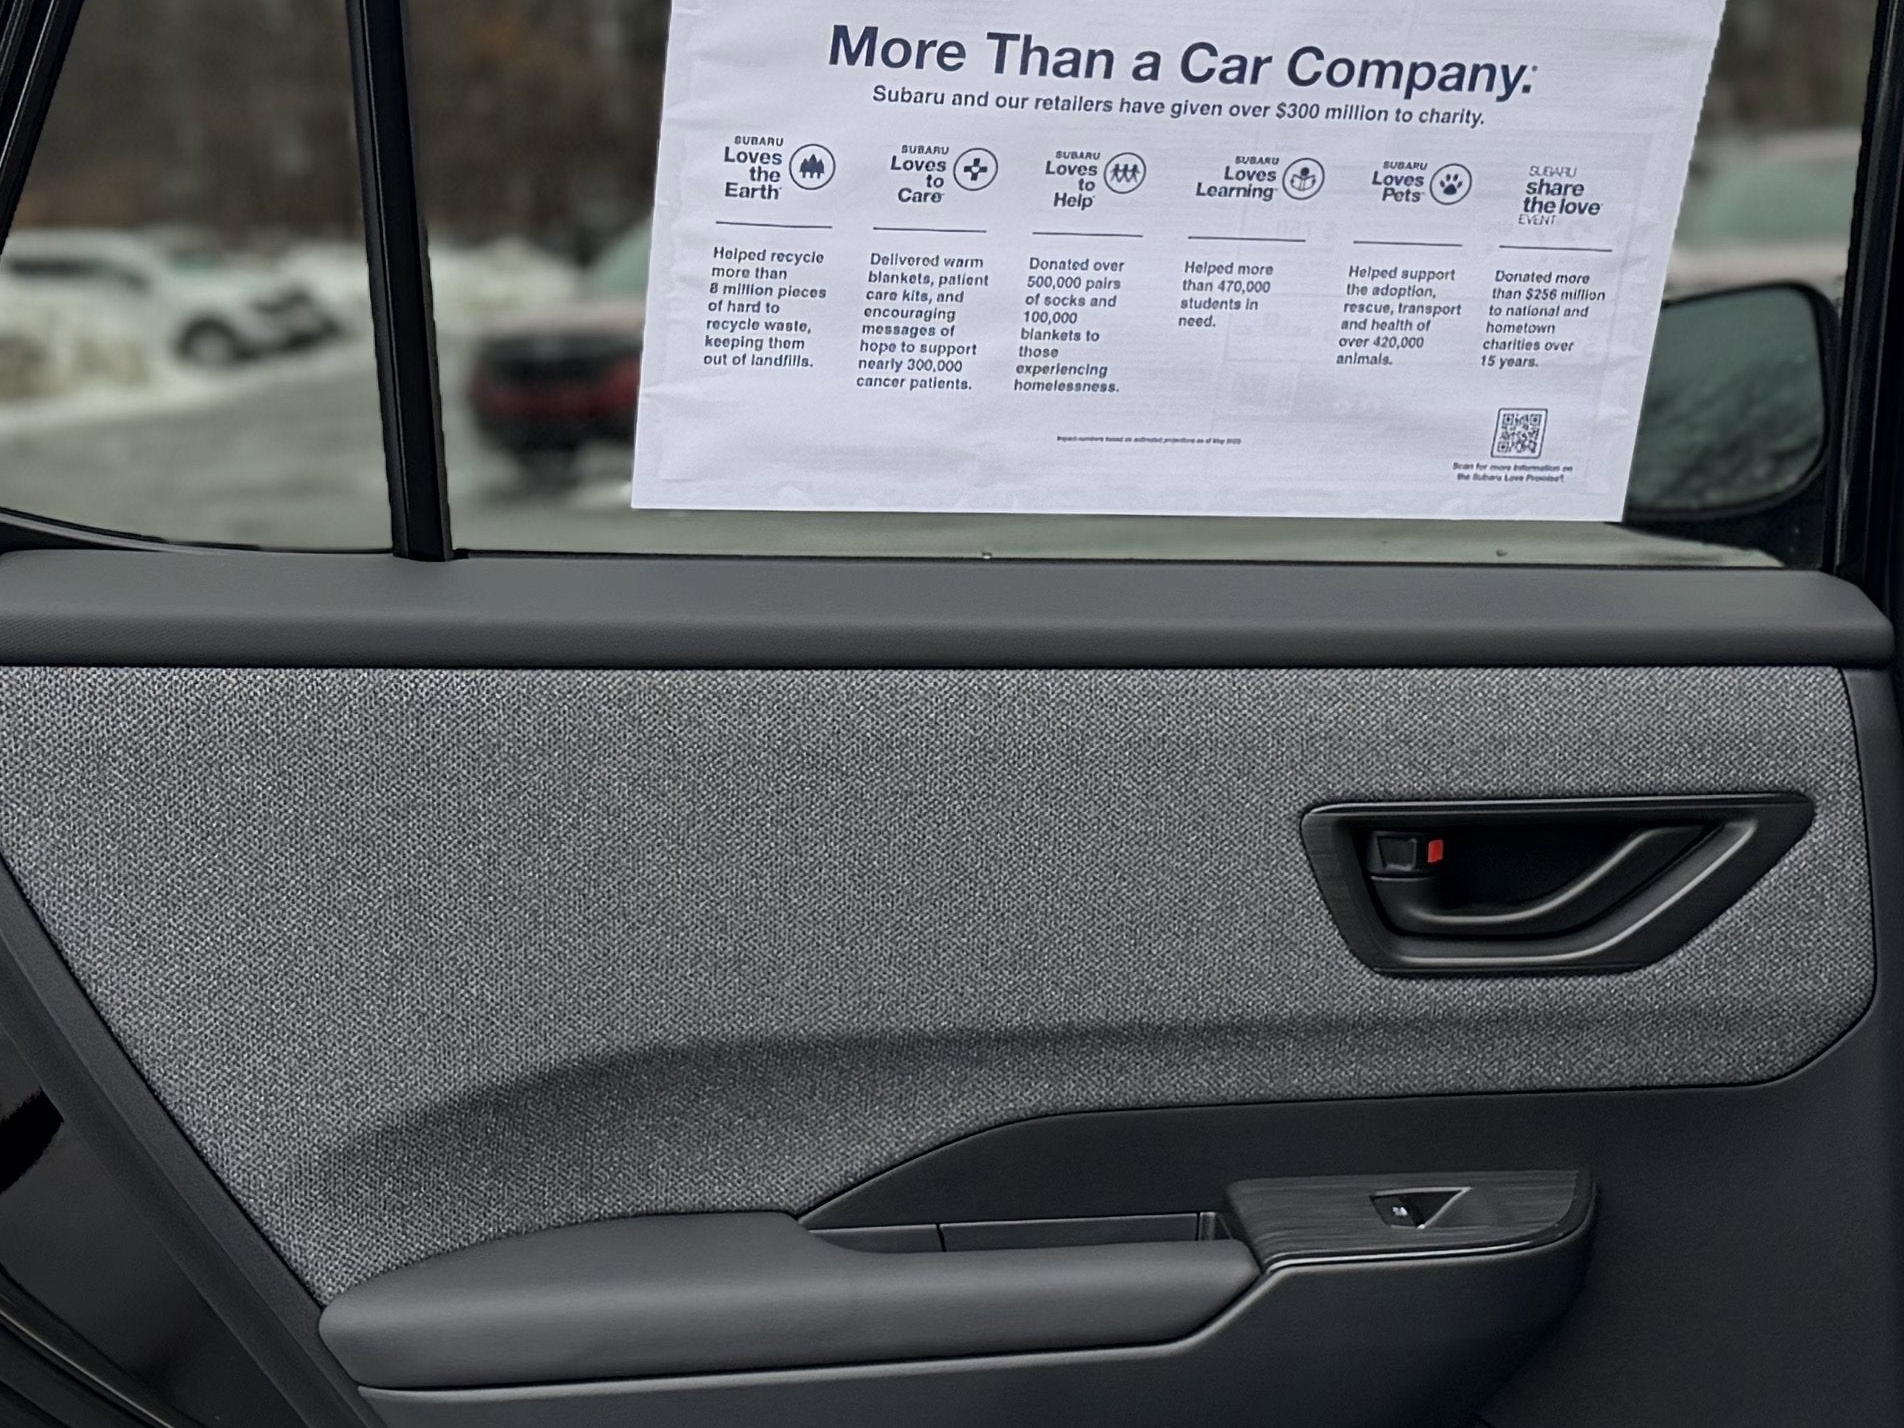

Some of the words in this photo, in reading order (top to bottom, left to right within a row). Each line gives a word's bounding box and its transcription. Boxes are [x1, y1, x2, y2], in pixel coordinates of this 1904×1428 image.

[829, 24, 967, 72] More
[986, 31, 1115, 80] Than
[1131, 50, 1161, 82] a
[1180, 41, 1273, 85] Car
[872, 84, 945, 105] Subaru
[951, 90, 990, 108] and
[995, 95, 1030, 110] our
[1034, 95, 1113, 113] retailers
[1119, 97, 1166, 115] have
[1170, 99, 1223, 119] given
[1228, 104, 1271, 118] over
[1275, 101, 1320, 120] $300
[1324, 104, 1389, 122] million
[1394, 107, 1414, 123] to
[1418, 107, 1484, 129] charity.
[734, 135, 784, 147] SUBARU
[723, 145, 783, 164] Loves
[901, 144, 950, 156] SUBARU
[1055, 150, 1101, 161] SUBARU
[890, 155, 947, 173] Loves
[1045, 160, 1098, 177] Loves
[1235, 155, 1280, 166] SUBARU
[1382, 160, 1428, 171] SUBARU
[749, 165, 781, 183] the
[1224, 165, 1277, 183] Loves
[1371, 170, 1425, 189] Loves
[1528, 165, 1578, 179] SUBARU
[926, 173, 945, 189] to
[1078, 177, 1096, 192] to
[1525, 178, 1585, 198] share
[1523, 195, 1557, 214] the
[1518, 213, 1556, 226] EVENT
[713, 246, 767, 264] Helped
[770, 251, 825, 266] recycle
[870, 252, 940, 267] Delivered
[943, 257, 984, 268] warm
[1029, 256, 1090, 271] Donated
[1093, 261, 1125, 272] over
[711, 267, 751, 279] more
[755, 266, 788, 280] than
[1184, 260, 1235, 277] Helped
[1237, 265, 1274, 276] more
[1348, 265, 1398, 282] Helped
[1400, 269, 1456, 283] support
[868, 270, 934, 287] blankets,
[938, 273, 989, 288] patient
[1026, 275, 1082, 291] 500,000
[1084, 276, 1121, 293] pairs
[1494, 269, 1553, 284] Donated
[1555, 274, 1591, 285] more
[709, 281, 719, 294] 8
[722, 282, 774, 297] million
[777, 284, 827, 300] pieces
[1182, 278, 1214, 292] than
[1217, 279, 1271, 295] 470,000
[1346, 283, 1369, 296] the
[1371, 283, 1437, 300] adoption,
[1492, 287, 1522, 300] than
[1525, 287, 1558, 301] $256
[1560, 288, 1606, 301] million
[865, 290, 898, 301] care
[902, 289, 933, 305] kits,
[936, 290, 965, 303] and
[1024, 292, 1041, 306] of
[1043, 294, 1086, 307] socks
[1089, 295, 1118, 308] and
[1180, 296, 1242, 311] students
[1245, 297, 1259, 311] in
[707, 299, 724, 312] of
[726, 299, 762, 314] hard
[765, 301, 780, 314] to
[1343, 302, 1394, 316] rescue,
[1397, 302, 1462, 318] transport
[1488, 304, 1503, 317] to
[1505, 304, 1561, 317] national
[1563, 306, 1590, 318] and
[863, 307, 956, 323] encouraging
[1024, 310, 1078, 326] 100,000
[1178, 314, 1216, 328] need.
[706, 317, 760, 334] recycle
[764, 320, 812, 335] waste,
[861, 324, 936, 339] messages
[940, 324, 956, 337] of
[1340, 318, 1368, 331] and
[1370, 318, 1413, 332] health
[1416, 319, 1432, 332] of
[1485, 320, 1556, 335] hometown
[1020, 327, 1081, 342] blankets
[1085, 329, 1100, 342] to
[1338, 337, 1370, 348] over
[1372, 335, 1425, 350] 420,000
[704, 334, 764, 352] keeping
[768, 336, 805, 350] them
[859, 339, 897, 356] hope
[900, 340, 916, 353] to
[919, 343, 977, 358] support
[1482, 337, 1541, 351] charities
[1544, 341, 1575, 352] over
[703, 353, 728, 366] out
[731, 352, 747, 366] of
[751, 353, 814, 368] landfills.
[1018, 345, 1059, 359] those
[1336, 351, 1393, 366] animals.
[858, 357, 904, 374] nearly
[906, 357, 963, 373] 300,000
[1481, 354, 1496, 367] 15
[1498, 357, 1539, 370] years.
[1015, 362, 1108, 379] experiencing
[856, 376, 906, 388] cancer
[909, 376, 972, 392] patients.
[1013, 378, 1120, 393] homelessness.
